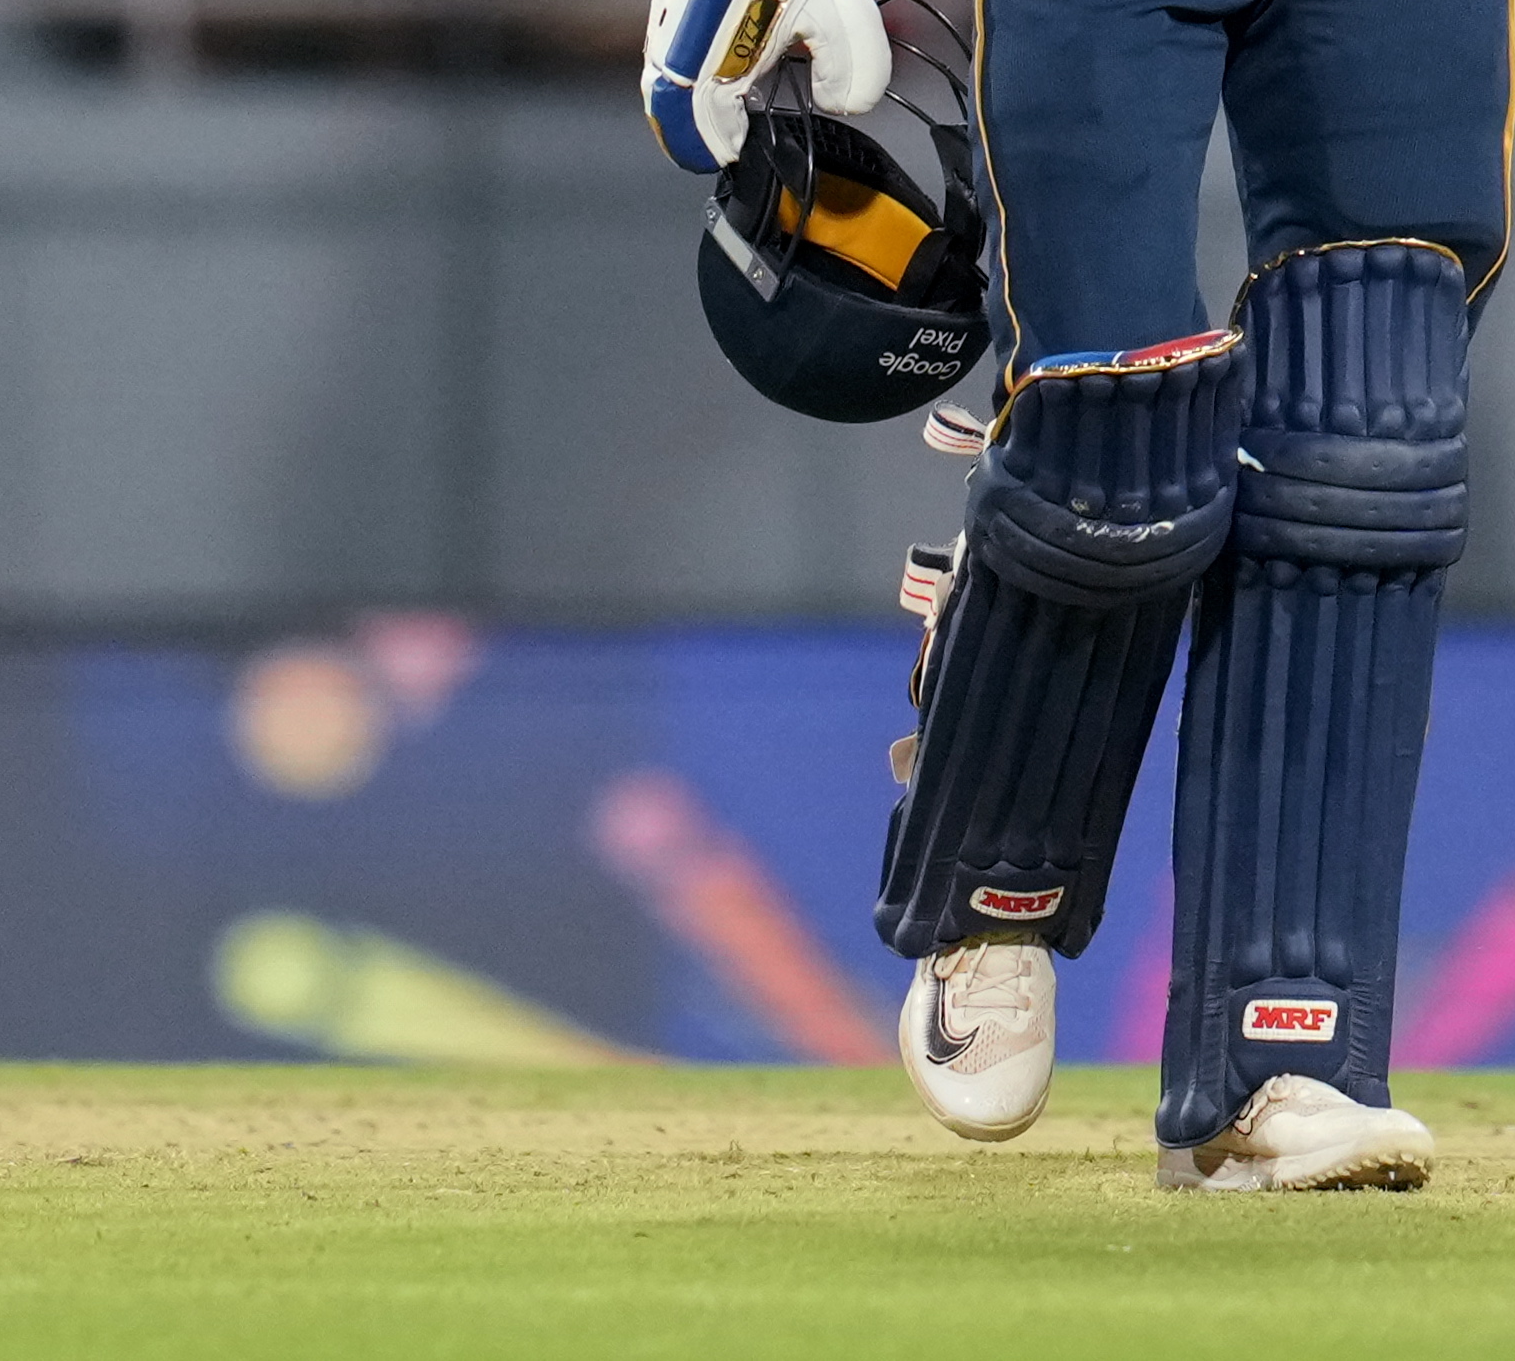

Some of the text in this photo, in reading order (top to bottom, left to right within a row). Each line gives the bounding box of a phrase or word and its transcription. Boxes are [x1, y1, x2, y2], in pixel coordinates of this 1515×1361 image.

[909, 327, 968, 353] Pixel
[879, 352, 961, 380] Google
[979, 890, 1062, 913] MRF
[1252, 1006, 1332, 1031] MRF
